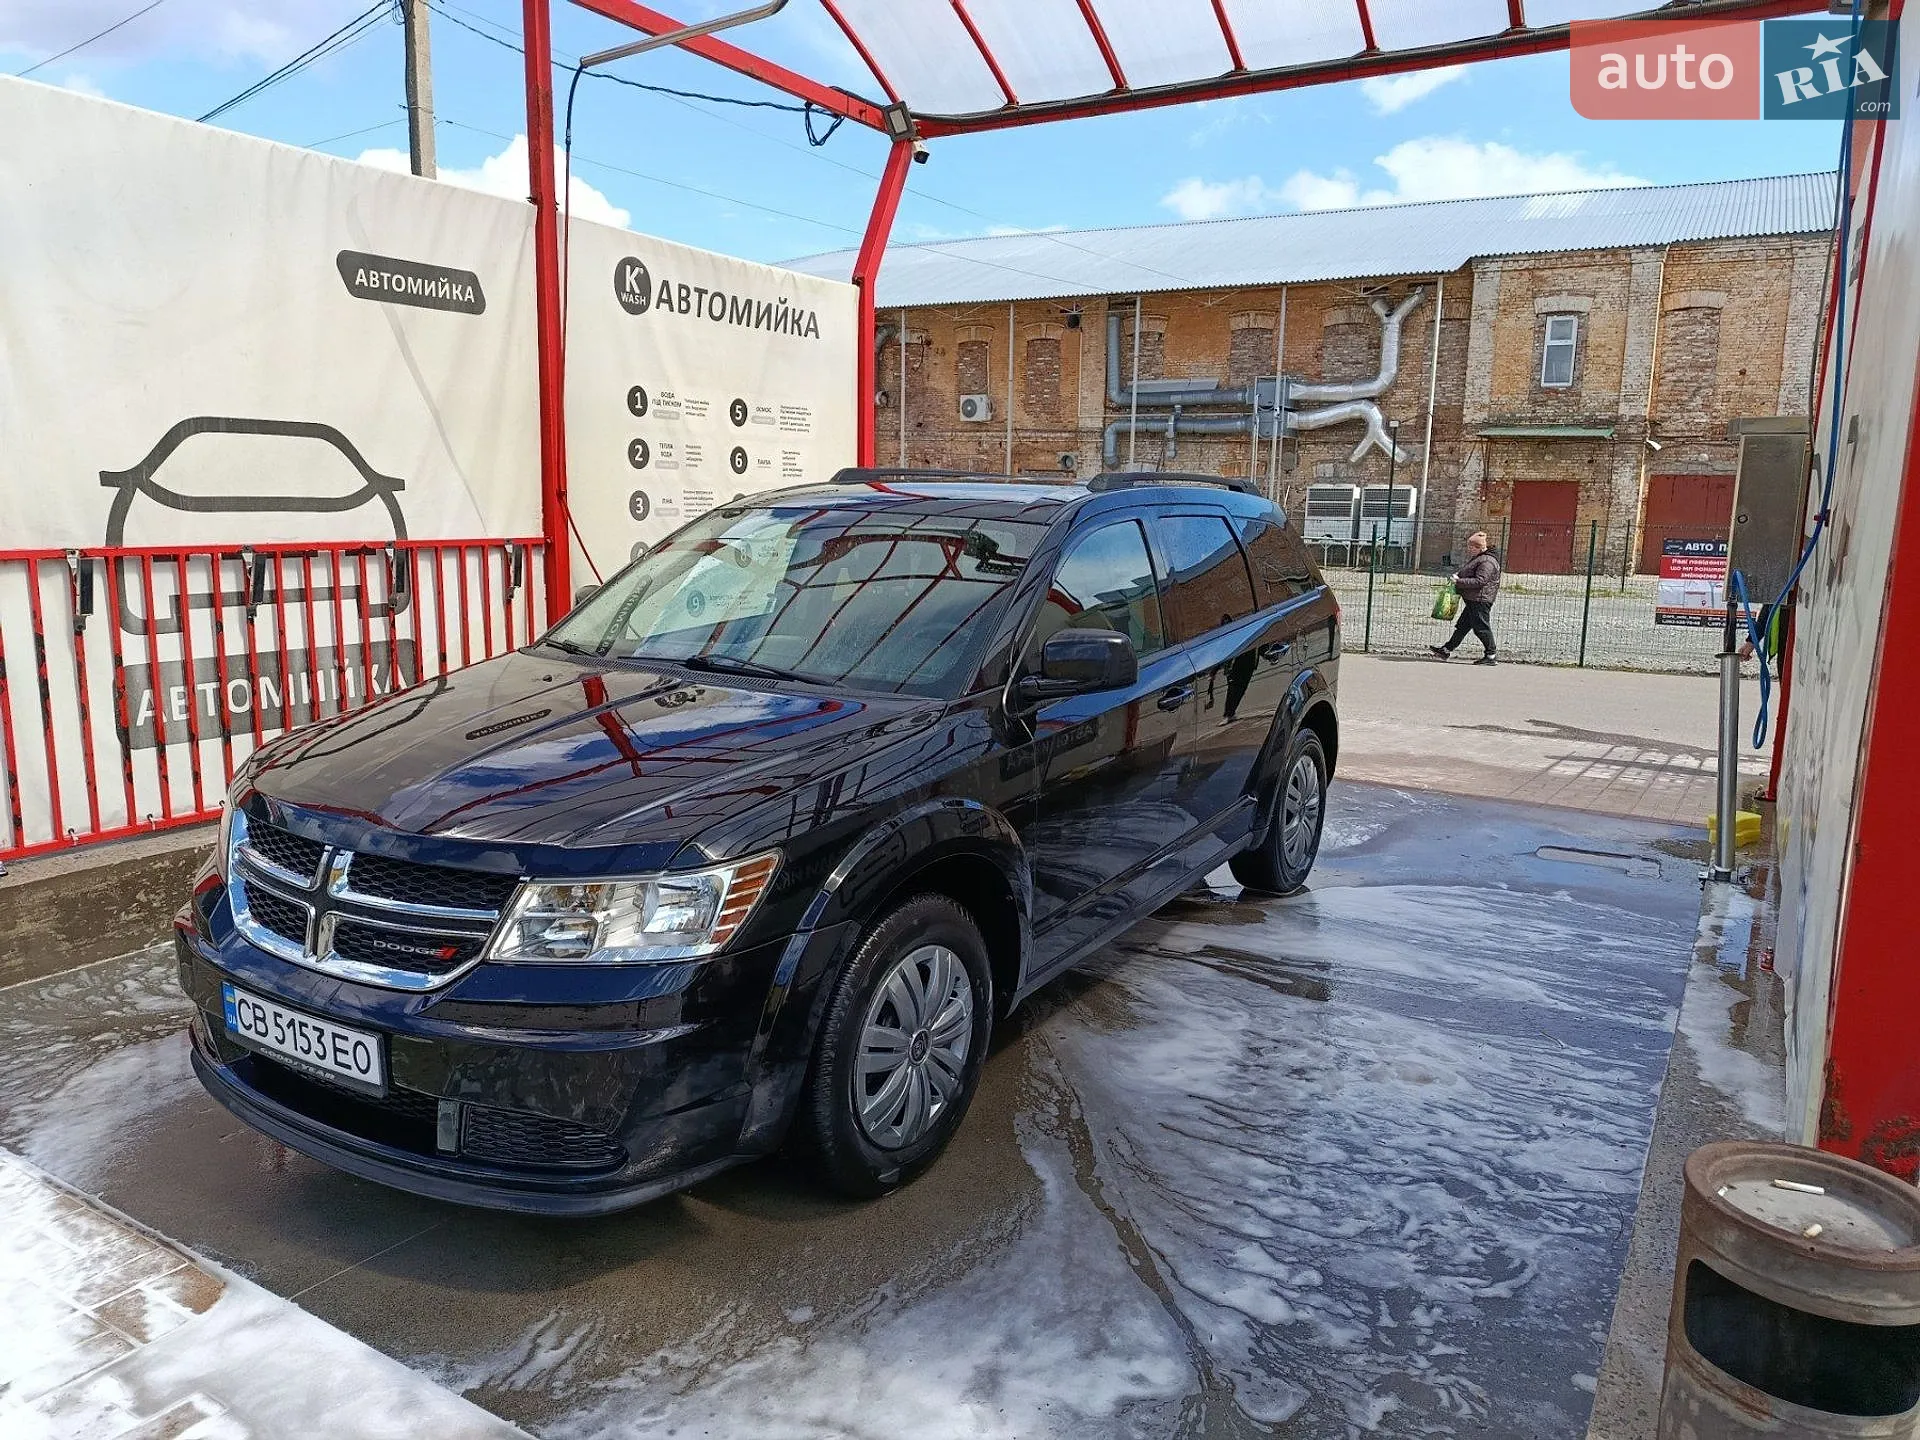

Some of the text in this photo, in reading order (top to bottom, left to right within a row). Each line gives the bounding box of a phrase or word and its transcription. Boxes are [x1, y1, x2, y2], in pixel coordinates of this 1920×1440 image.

[354, 266, 475, 304] АВТОМИЙКА
[625, 264, 644, 294] K
[620, 291, 646, 306] WASH
[655, 279, 821, 339] АВТОМИЙКА
[634, 391, 643, 408] 1
[735, 405, 743, 420] 5
[634, 444, 643, 461] 2
[735, 452, 743, 468] 6
[635, 497, 643, 514] 3
[1684, 543, 1714, 552] АВТО
[373, 939, 438, 956] DODGE
[237, 997, 372, 1076] CB 5153 EO
